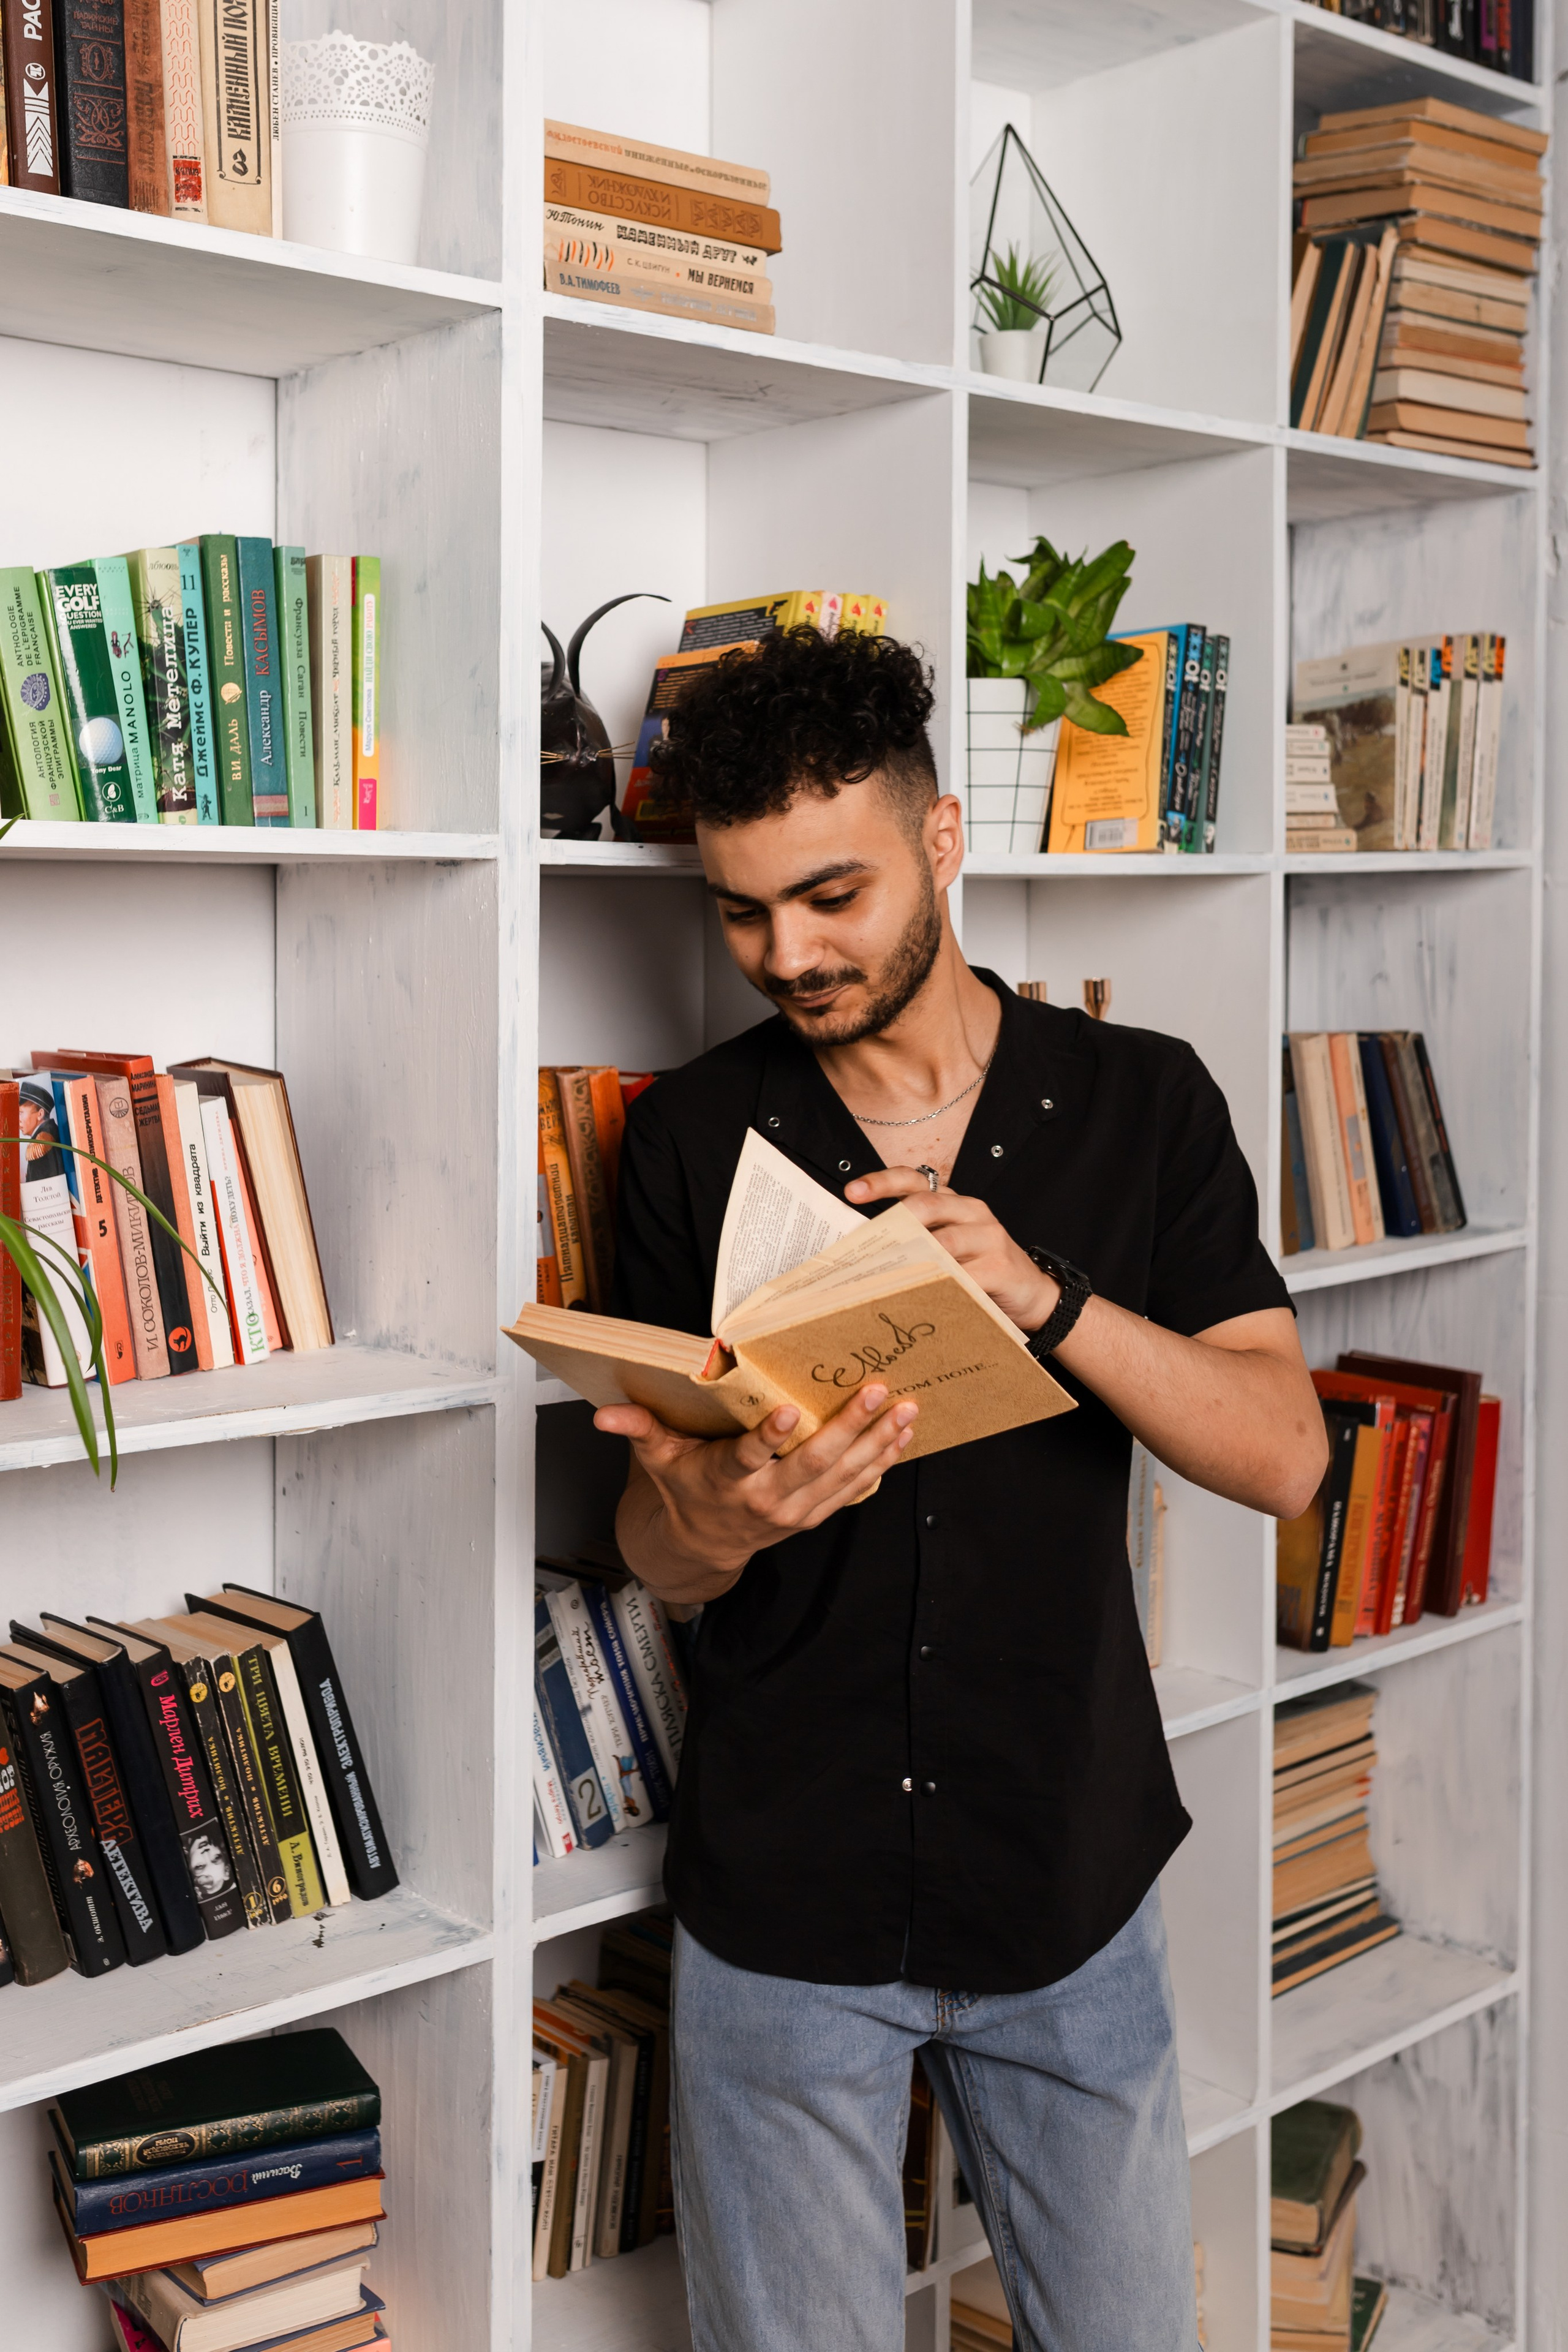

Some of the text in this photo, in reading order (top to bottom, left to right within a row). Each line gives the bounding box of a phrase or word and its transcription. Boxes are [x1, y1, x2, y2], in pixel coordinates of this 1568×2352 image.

[80, 21, 113, 34] ТАЙНЫ
[222, 33, 251, 141] КАМЕННЫЙ
[271, 68, 279, 105] СТАНЕВ
[271, 108, 280, 141] ЛЮБЕН
[588, 190, 671, 221] ИСКУССТВО
[575, 276, 621, 295] ТИМОФЕЕВ
[687, 268, 755, 295] МЫ ВЕРНЕМСЯ
[55, 584, 97, 598] EVERY
[180, 574, 197, 591] 11
[219, 554, 232, 603] рассказы
[13, 586, 33, 666] DE L'EPIGRAMME
[56, 595, 100, 612] GOLF
[59, 611, 102, 620] QUESTION
[364, 600, 373, 628] РАБОТУ
[7, 605, 24, 668] ANTHOLOGIE
[26, 611, 42, 666] FRANÇAISE
[222, 620, 235, 666] Повести
[364, 630, 373, 655] СВОЮ
[185, 607, 209, 778] Джеймс Ф. КУПЕР
[251, 589, 273, 766] Александр КАСЫМОВ
[293, 597, 309, 758] Франсуаза Саган Повести
[364, 655, 373, 683] НАЙДИ
[160, 605, 187, 802] Катя Метелица
[364, 688, 372, 723] Светлова
[29, 721, 46, 778] АНТОЛОГИЯ
[38, 720, 58, 791] ФРАНЦУЗСКОЙ
[47, 718, 65, 780] ЭПИГРАММЫ
[121, 670, 145, 799] матрица MANOLO
[228, 718, 241, 755] ДАЛЬ
[105, 804, 124, 814] C&B
[130, 1069, 155, 1081] Александр
[33, 1192, 61, 1203] Толстой
[92, 1167, 104, 1204] ДЕТЕКТИВ
[188, 1144, 210, 1256] Выйти из квадрата
[224, 1175, 239, 1223] ПОХУДЕТЬ?
[38, 1219, 64, 1231] рассказы
[98, 1219, 108, 1237] 5
[233, 1224, 246, 1261] ДОЛЖНА
[548, 1163, 574, 1283] Пятнадцатилетний
[565, 1194, 580, 1245] капитан
[123, 1166, 156, 1332] СОКОЛОВ-МИКИТОВ
[239, 1269, 250, 1286] ЧТО
[244, 1313, 266, 1354] КТО
[886, 1379, 932, 1399] СТОМ
[627, 1596, 656, 1673] СМЕРТИ
[649, 1671, 682, 1747] ПЛЯСКА
[158, 1694, 205, 1819] Марлен Дитрих
[234, 1727, 254, 1781] ПОЛИТИКА
[247, 1655, 294, 1817] ТРИ ЦВЕТА ВРЕМЕНИ
[207, 1736, 228, 1791] ПОЛИТИКА
[318, 1677, 382, 1869] АВТОМАТИЗИРОВАННЫЙ ЭЛЕКТРОПРИВОД
[40, 1730, 83, 1851] АРХЕОЛОГИЯ ОРУЖИЯ
[579, 1778, 602, 1822] 2
[74, 1717, 154, 1934] МАСТЕРА ДЕТЕКТИВА
[224, 1806, 245, 1855] ДЕТЕКТИВ
[250, 1796, 270, 1846] ДЕТЕКТИВ
[272, 1879, 282, 1893] 6
[293, 1853, 309, 1907] Виноградов
[85, 1896, 102, 1934] окшотт
[155, 2136, 179, 2146] ПОРЫ
[109, 2163, 303, 2215] Василий РОСЛЯКОВ
